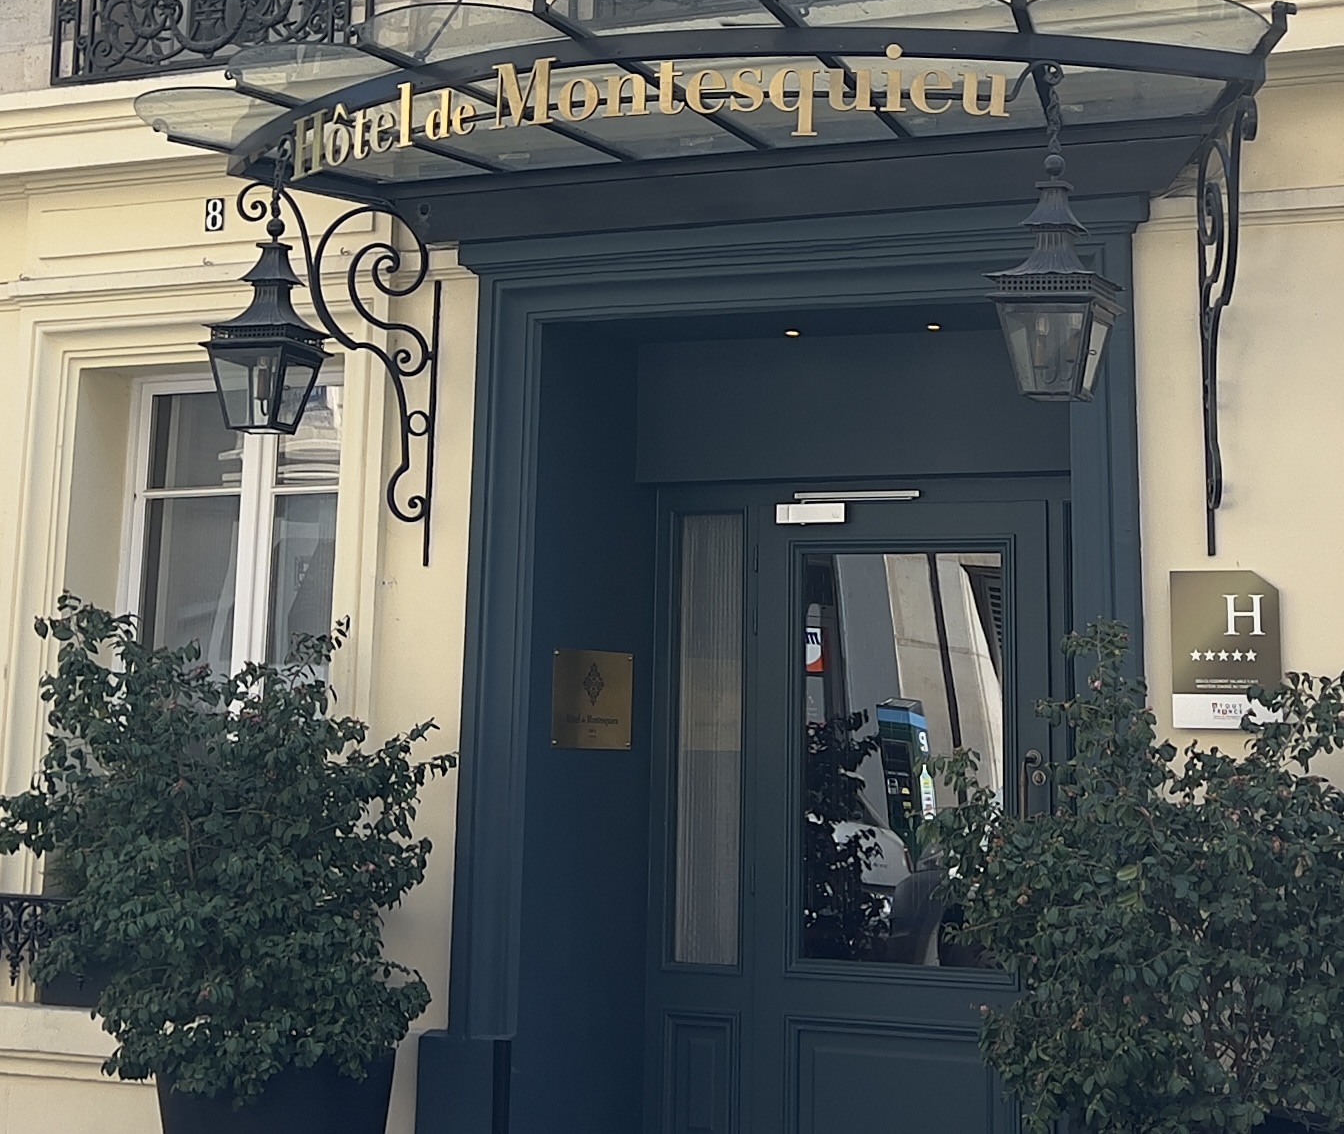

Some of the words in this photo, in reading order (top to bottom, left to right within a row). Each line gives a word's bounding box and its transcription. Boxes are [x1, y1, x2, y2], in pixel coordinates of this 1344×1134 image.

[290, 82, 414, 181] Hôtel
[425, 88, 476, 141] de
[489, 42, 1011, 137] Montesquieu
[206, 199, 223, 230] 8
[1222, 594, 1266, 636] H
